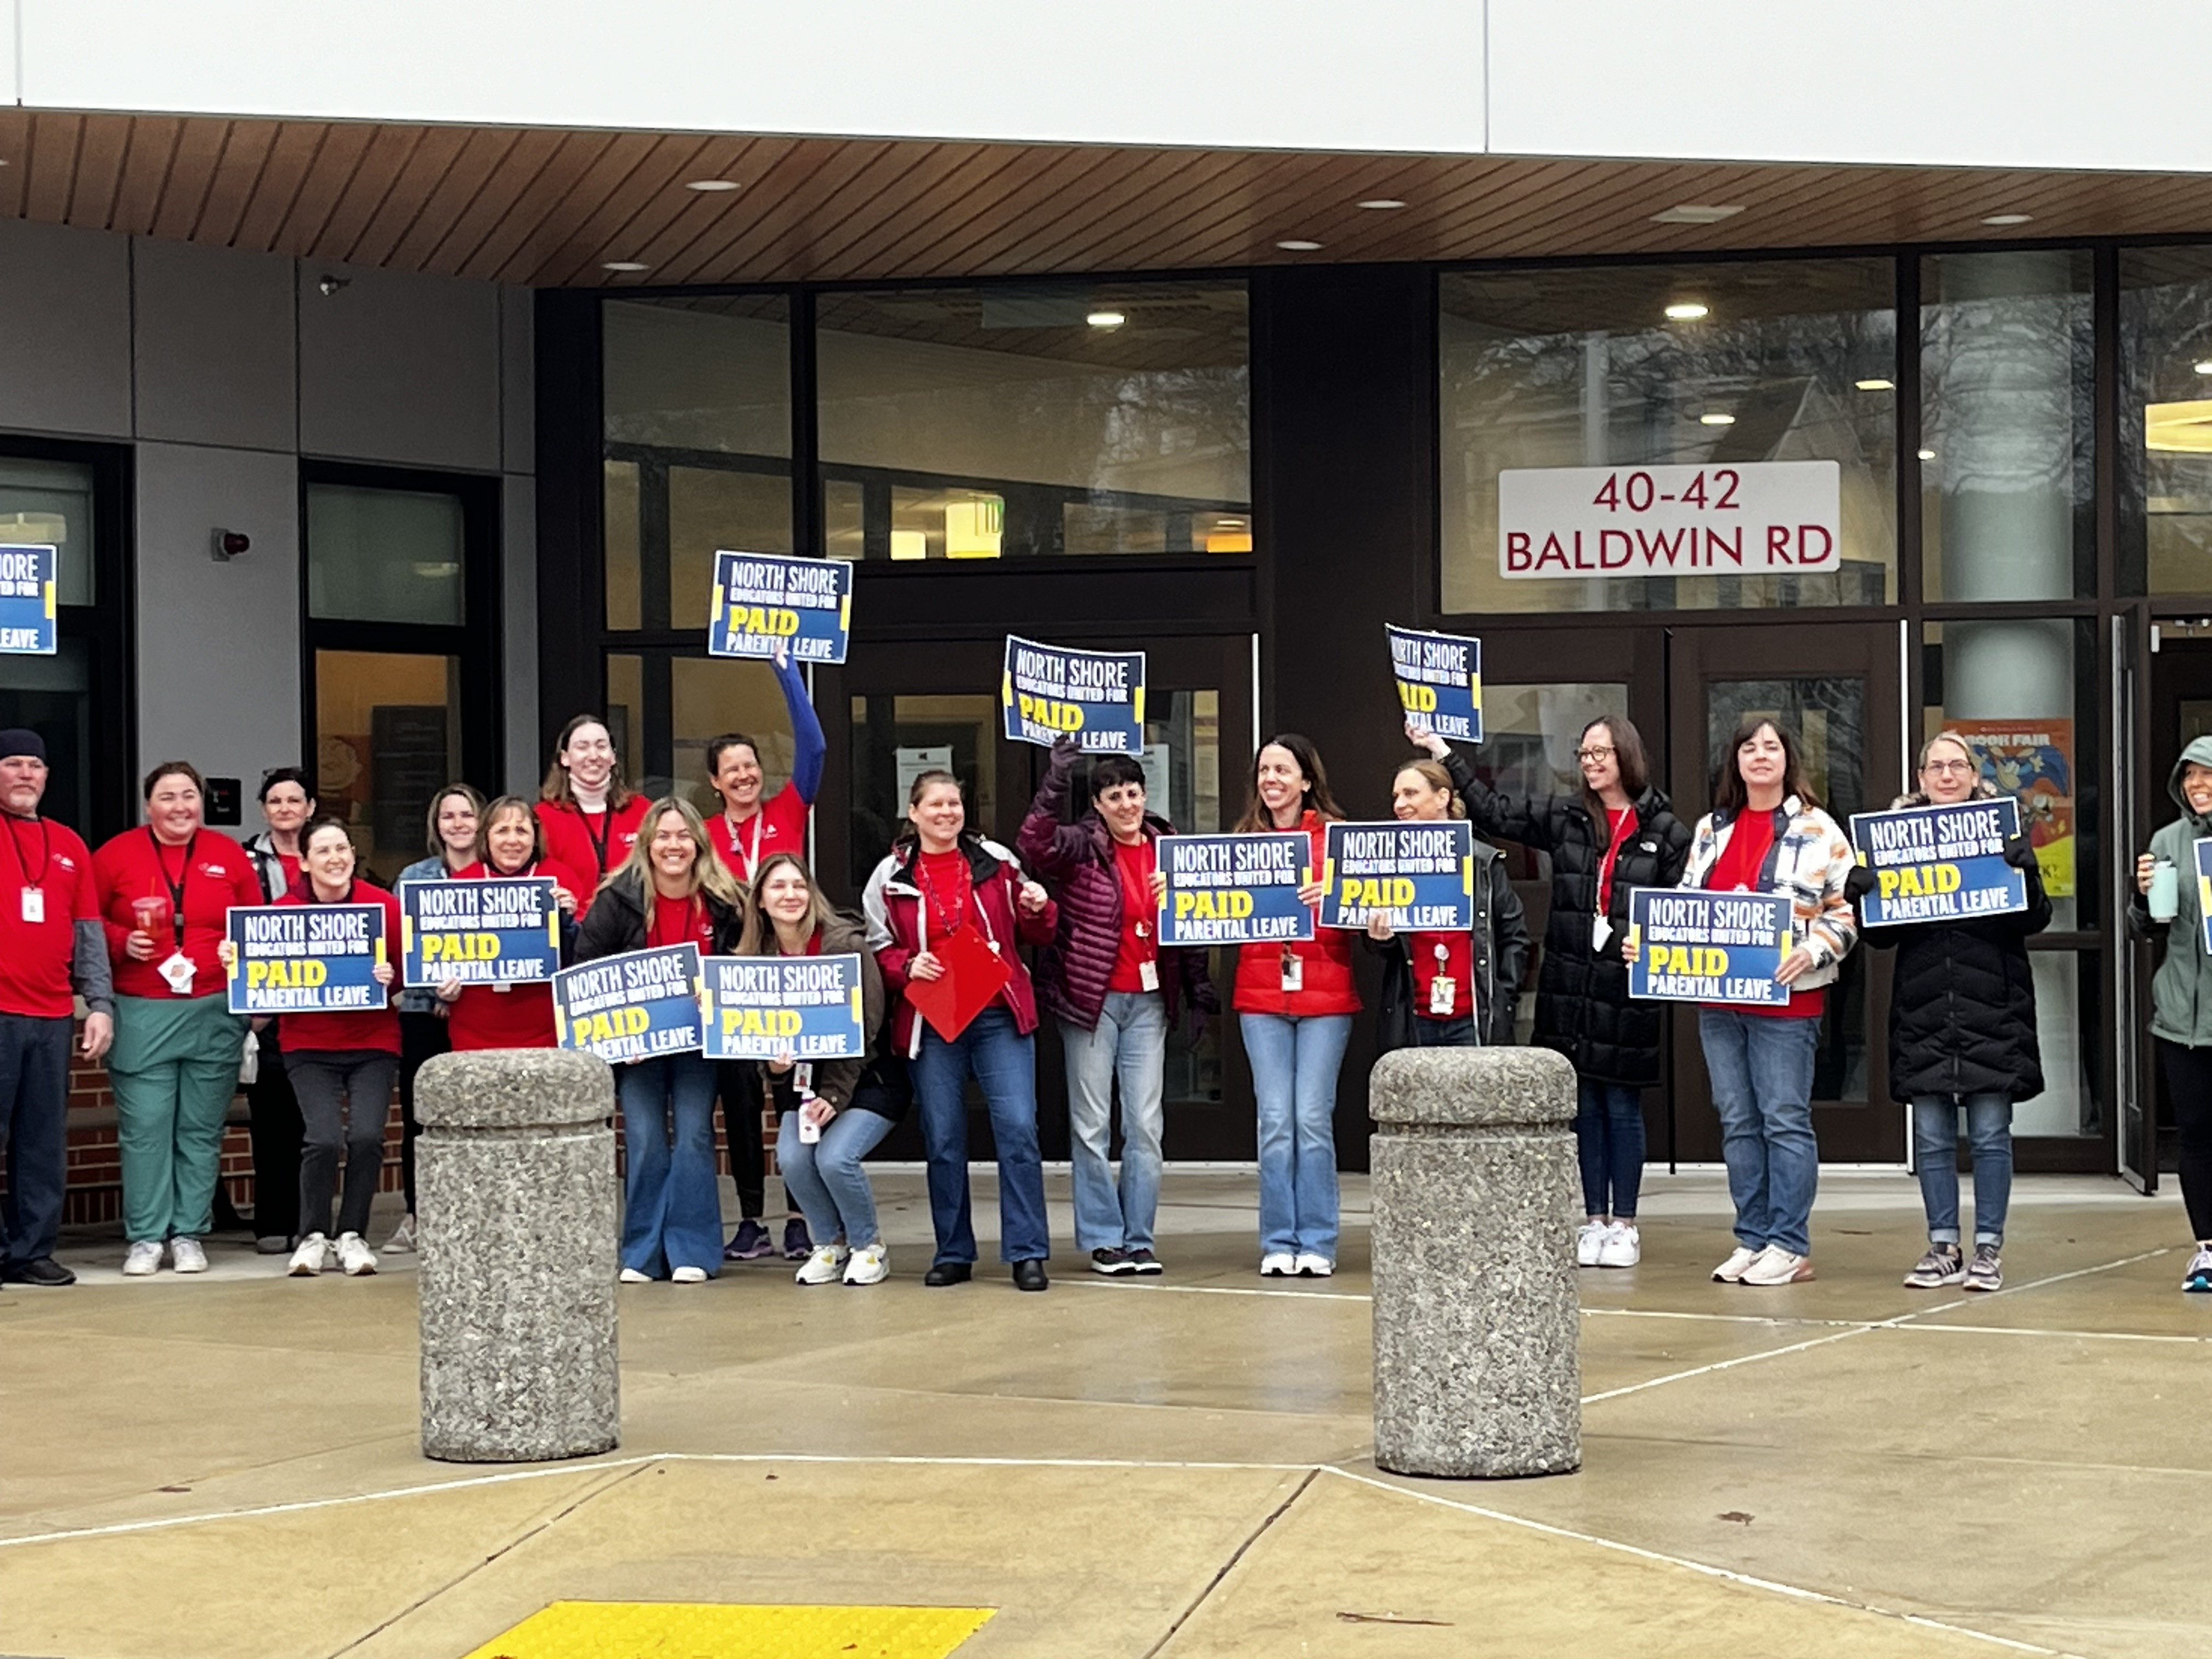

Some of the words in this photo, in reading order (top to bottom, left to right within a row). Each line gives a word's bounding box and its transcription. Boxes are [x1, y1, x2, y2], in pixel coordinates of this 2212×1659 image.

[1593, 469, 1740, 512] 40-42
[1506, 526, 1742, 572] BALDWIN
[1766, 524, 1832, 566] RD
[0, 554, 38, 581] ORE
[731, 561, 786, 590] NORTH
[787, 566, 839, 595] SHORE
[728, 605, 799, 636] PAID
[0, 628, 39, 649] EAVE
[792, 637, 833, 658] LEAVE
[1390, 635, 1421, 666] RTH
[1424, 641, 1468, 672] SHORE
[1017, 648, 1065, 683] NORTH
[1069, 658, 1128, 689] SHORE
[1018, 693, 1084, 731] PAID
[1435, 713, 1470, 737] LEAVE
[1081, 731, 1127, 749] LEAVE
[2012, 733, 2050, 747] FAIR
[1344, 831, 1396, 858] NORTH
[1399, 830, 1457, 857] SHORE
[1870, 817, 1934, 850] NORTH
[1937, 809, 2002, 843] SHORE
[1173, 844, 1231, 872] NORTH
[1235, 841, 1295, 870] SHORE
[1874, 845, 1937, 866] EDUCATORS
[1340, 878, 1415, 906] PAID
[1877, 864, 1961, 899] PAID
[419, 888, 478, 915] NORTH
[482, 886, 541, 914] SHORE
[1175, 890, 1254, 919] PAID
[1649, 898, 1709, 927] NORTH
[1713, 900, 1776, 930] SHORE
[1880, 894, 1959, 920] PARENTAL
[1961, 886, 2010, 912] LEAVE
[245, 915, 305, 941] NORTH
[309, 913, 369, 940] SHORE
[1175, 918, 1249, 940] PARENTAL
[1251, 916, 1298, 938] LEAVE
[1337, 906, 1412, 927] PARTAL
[1413, 906, 1457, 926] LEAVE
[421, 933, 500, 962] PAID
[1648, 925, 1710, 943] EDUCATORS
[1751, 930, 1774, 946] FOR
[246, 960, 327, 988] PAID
[422, 961, 496, 982] PARENTAL
[499, 959, 544, 979] LEAVE
[1649, 945, 1729, 977] PAID
[567, 964, 623, 1002] NORTH
[624, 953, 686, 989] SHORE
[719, 965, 780, 991] NORTH
[783, 963, 845, 991] SHORE
[1647, 975, 1722, 997] PARENTAL
[1726, 978, 1773, 1000] LEAVE
[247, 988, 322, 1008] PARENTAL
[325, 985, 370, 1006] LEAVE
[572, 1007, 650, 1047] PAID
[721, 1008, 802, 1037] PAID
[577, 1037, 650, 1060] RENTAL
[650, 1026, 696, 1048] LEAVE
[721, 1035, 798, 1054] PARENTAL
[800, 1034, 847, 1053] LEAVE
